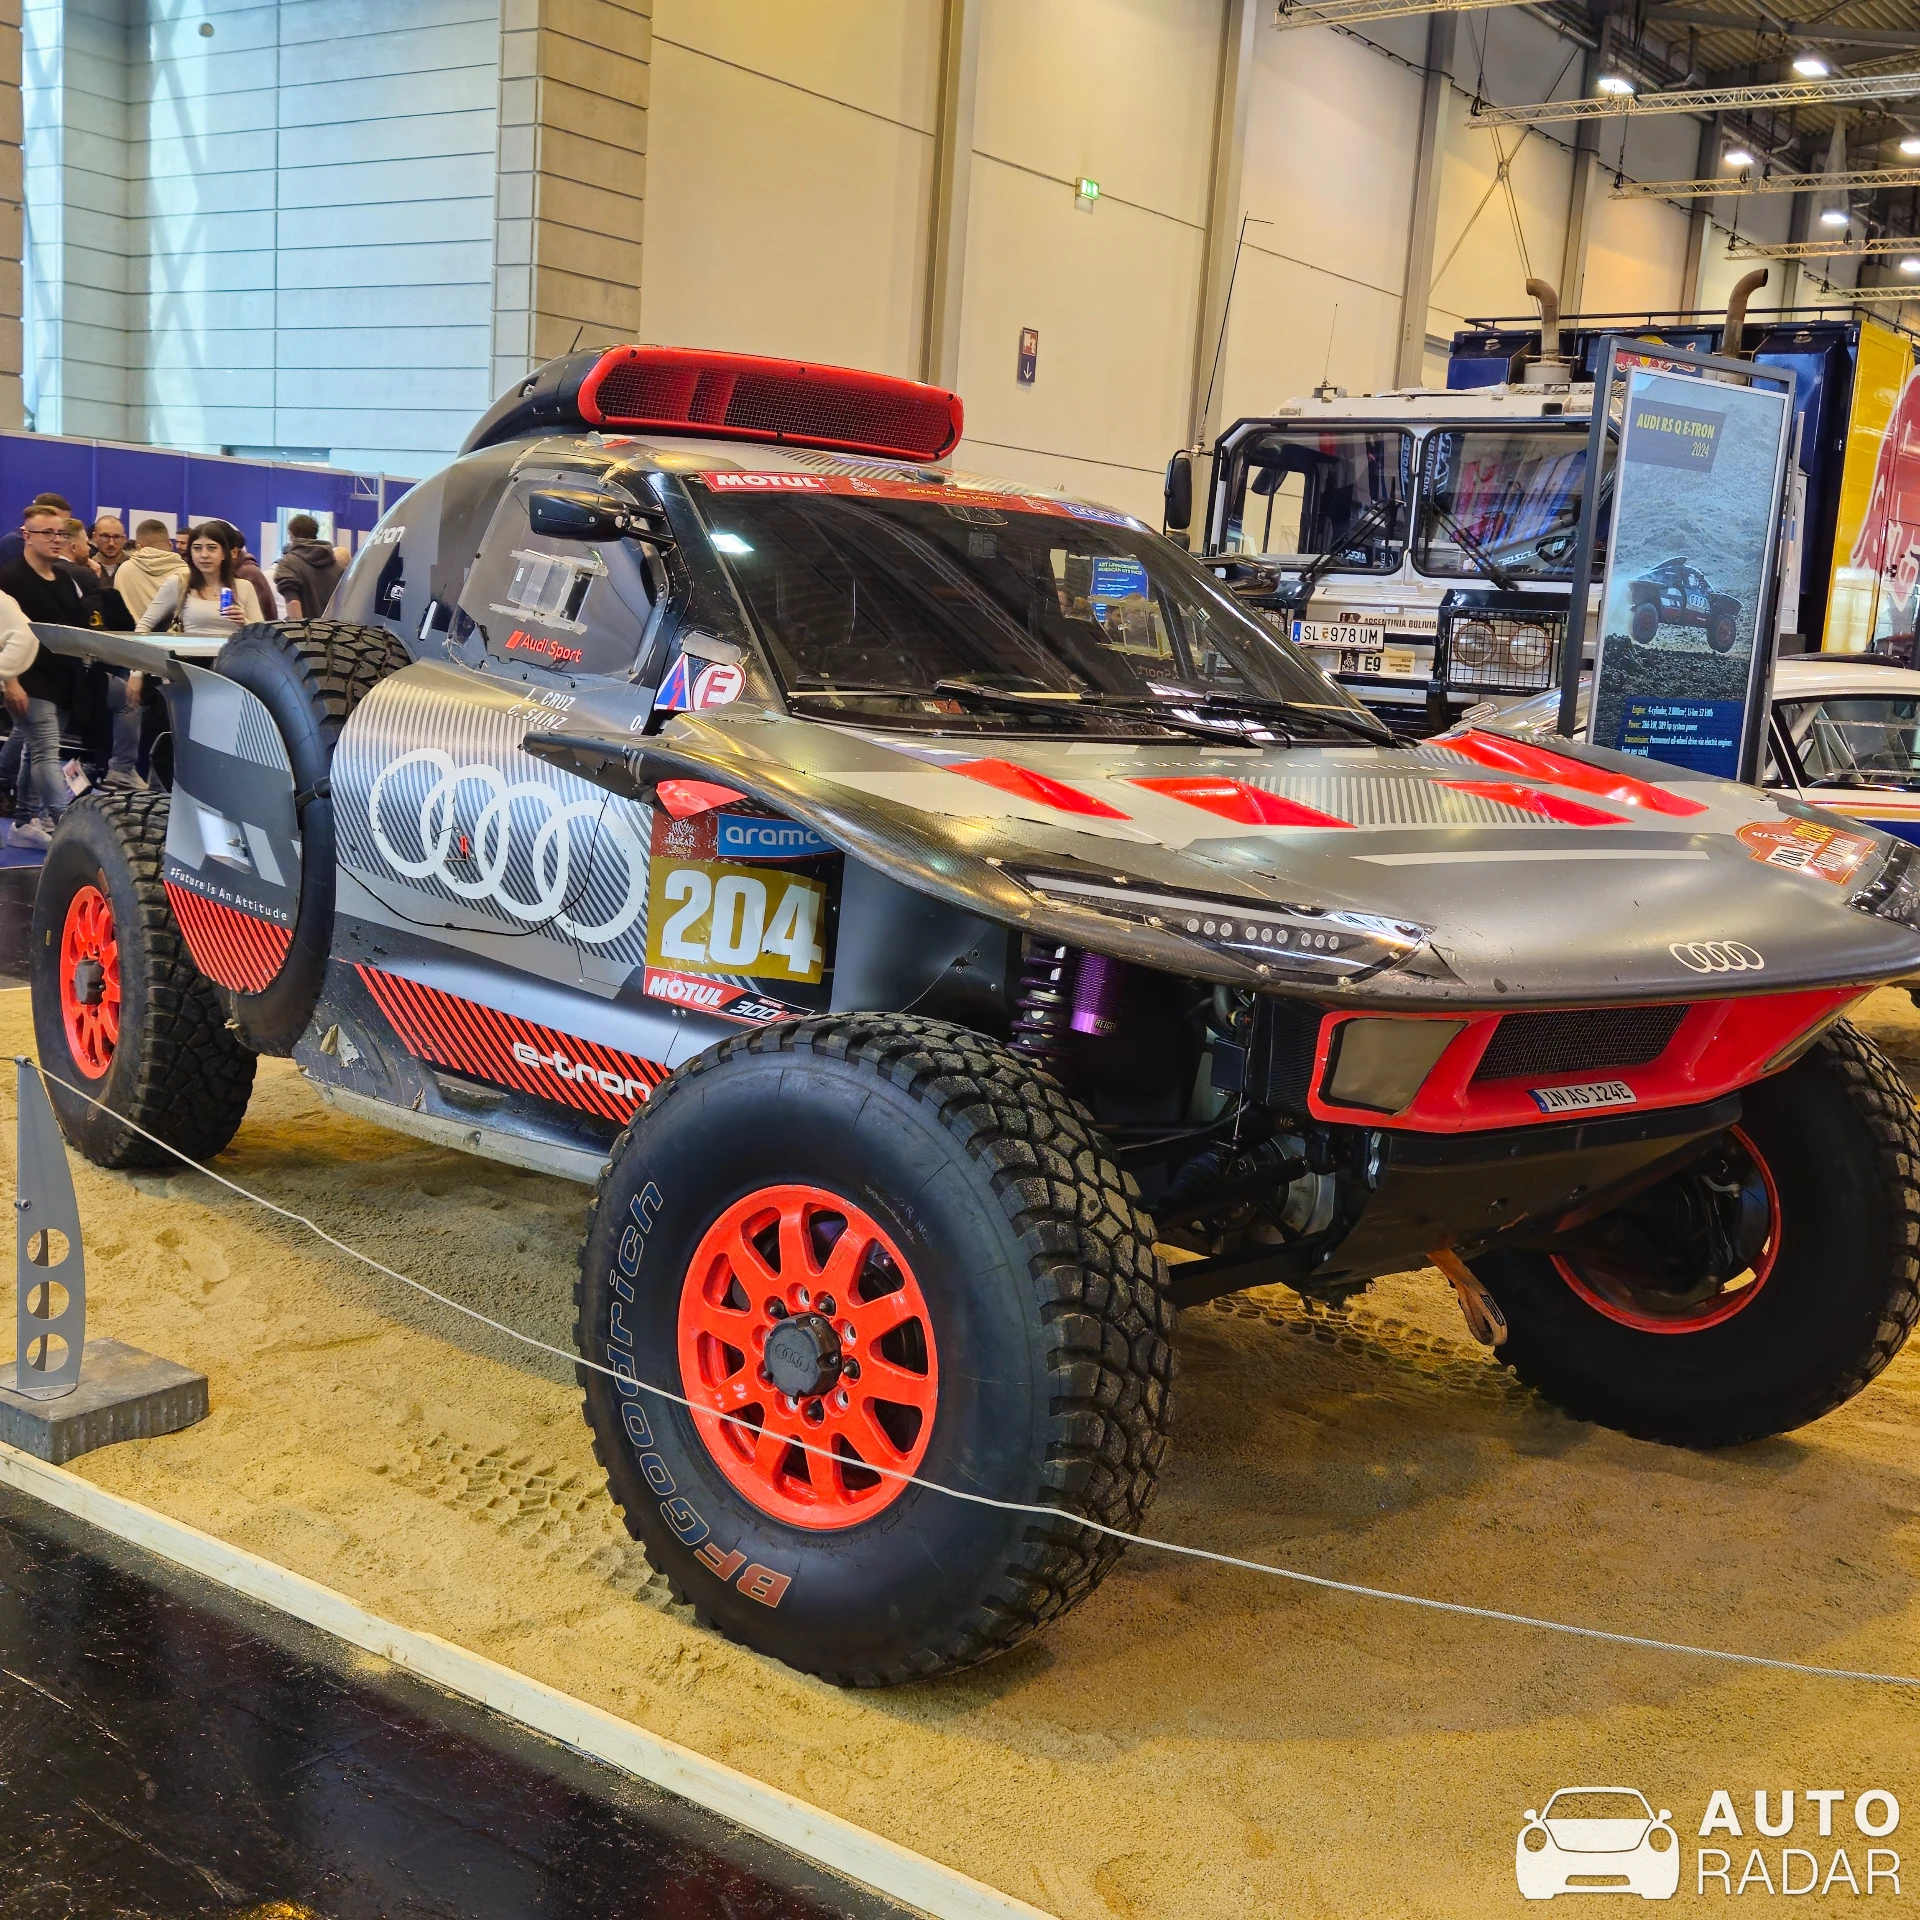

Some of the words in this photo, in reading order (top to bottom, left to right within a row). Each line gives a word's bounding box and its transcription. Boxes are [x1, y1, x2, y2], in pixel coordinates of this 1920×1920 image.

[1636, 413, 1660, 430] AUDI
[1661, 417, 1674, 432] RS
[1675, 419, 1681, 435] Q
[1683, 421, 1715, 439] E-TRON
[1691, 441, 1709, 458] 2024
[716, 475, 820, 487] MOTUL
[1304, 626, 1319, 641] SL
[1331, 627, 1356, 643] 978
[1359, 629, 1378, 645] UM
[1408, 620, 1436, 629] BOLIVIA
[521, 634, 549, 653] Audi
[548, 639, 582, 663] Sport
[1364, 657, 1381, 671] E9
[524, 688, 536, 701] L.
[540, 691, 576, 712] CRUZ
[507, 703, 519, 717] C.
[523, 706, 568, 730] SAINZ
[170, 867, 204, 889] #Future
[207, 882, 215, 895] Is
[219, 888, 231, 901] An
[235, 894, 287, 921] Attitude
[661, 869, 823, 974] 204
[648, 975, 725, 1006] MOTUL
[513, 1042, 651, 1101] e-tron
[1543, 1090, 1568, 1106] IN
[1566, 1088, 1590, 1104] AS
[1588, 1083, 1632, 1102] 124E
